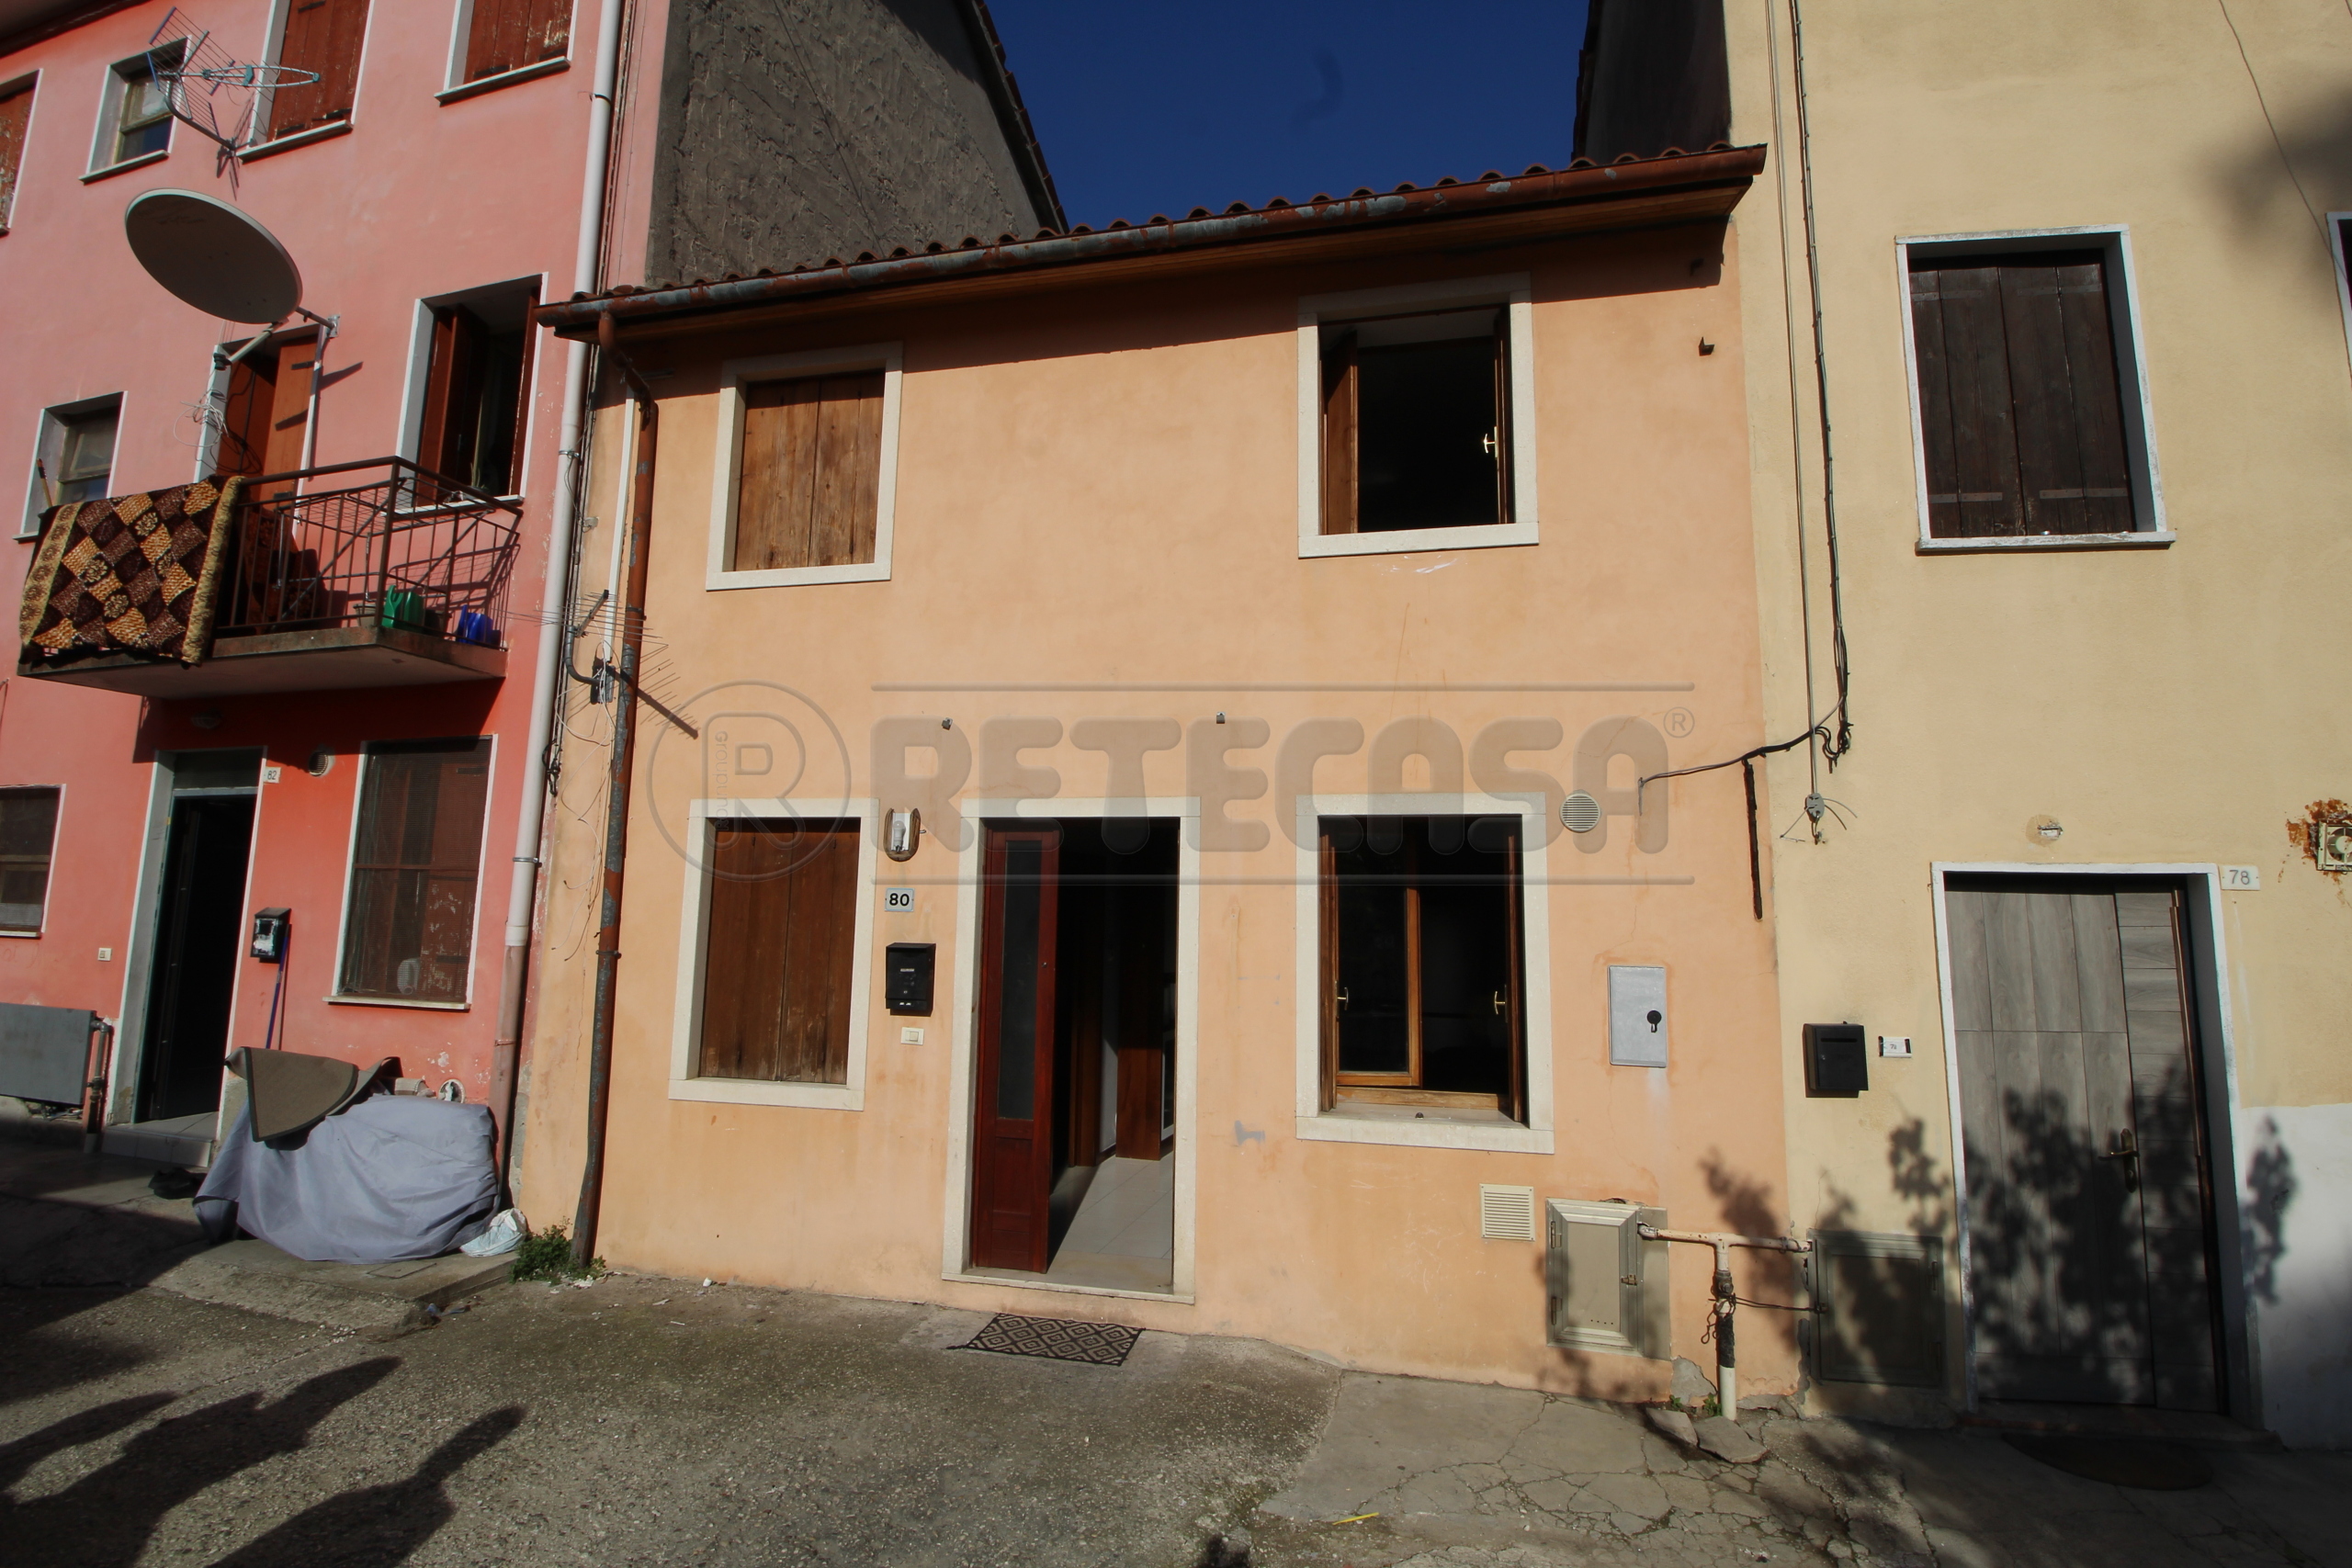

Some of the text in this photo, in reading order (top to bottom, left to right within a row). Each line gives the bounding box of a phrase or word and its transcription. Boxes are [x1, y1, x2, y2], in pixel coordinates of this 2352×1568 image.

[267, 770, 277, 780] 82
[2229, 869, 2250, 886] 78
[888, 893, 910, 907] 80
